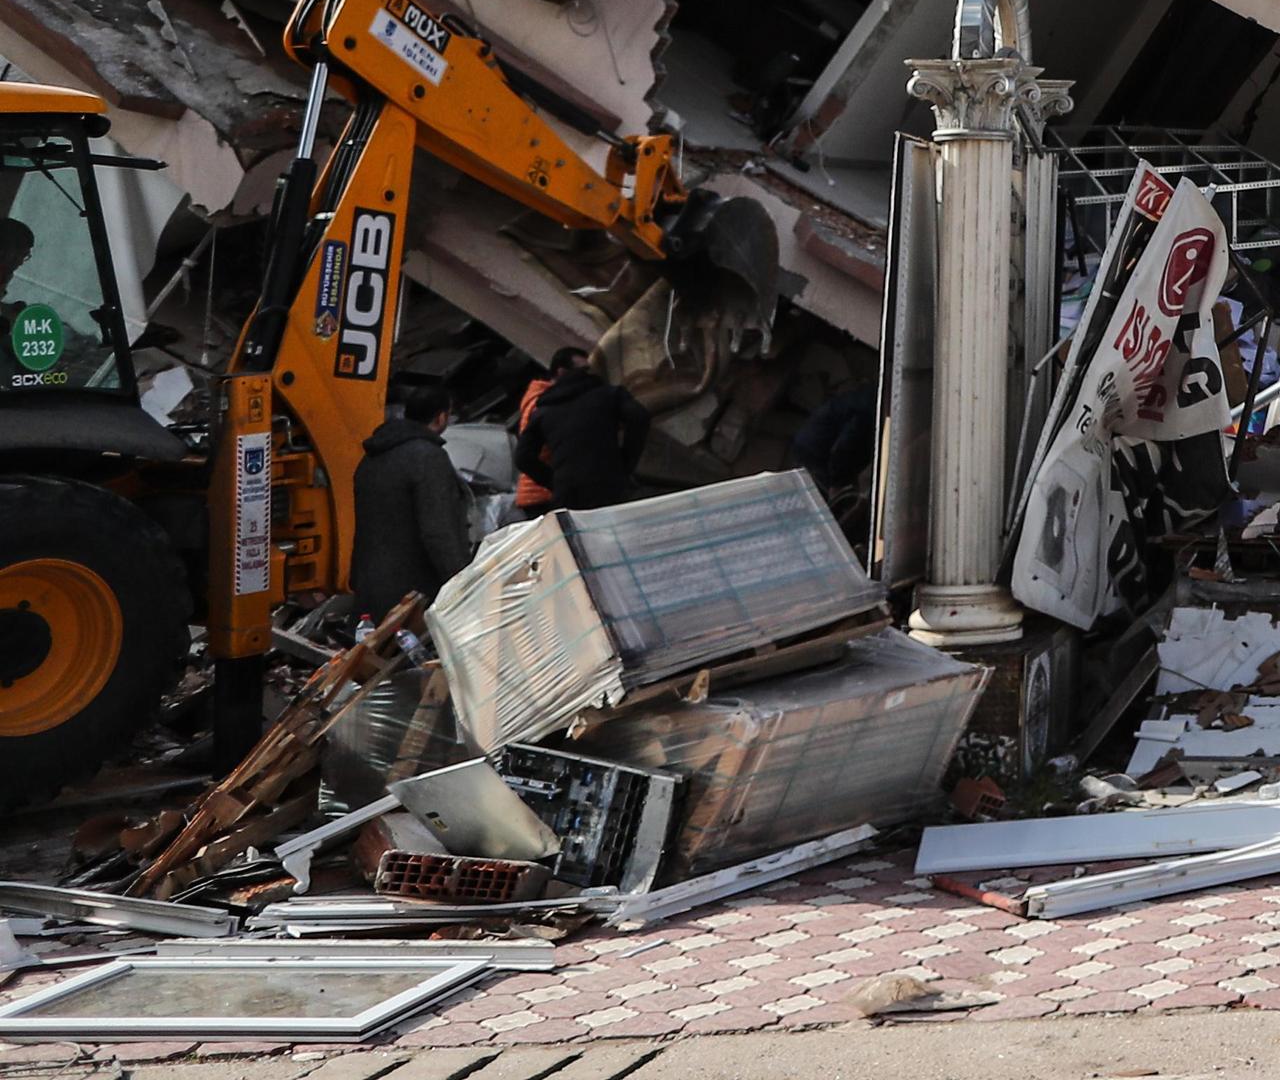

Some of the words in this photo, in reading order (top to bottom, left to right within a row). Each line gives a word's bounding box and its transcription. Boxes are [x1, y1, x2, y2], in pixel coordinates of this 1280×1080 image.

[342, 214, 391, 376] JCB
[23, 318, 53, 335] M-K
[22, 340, 56, 357] 2332
